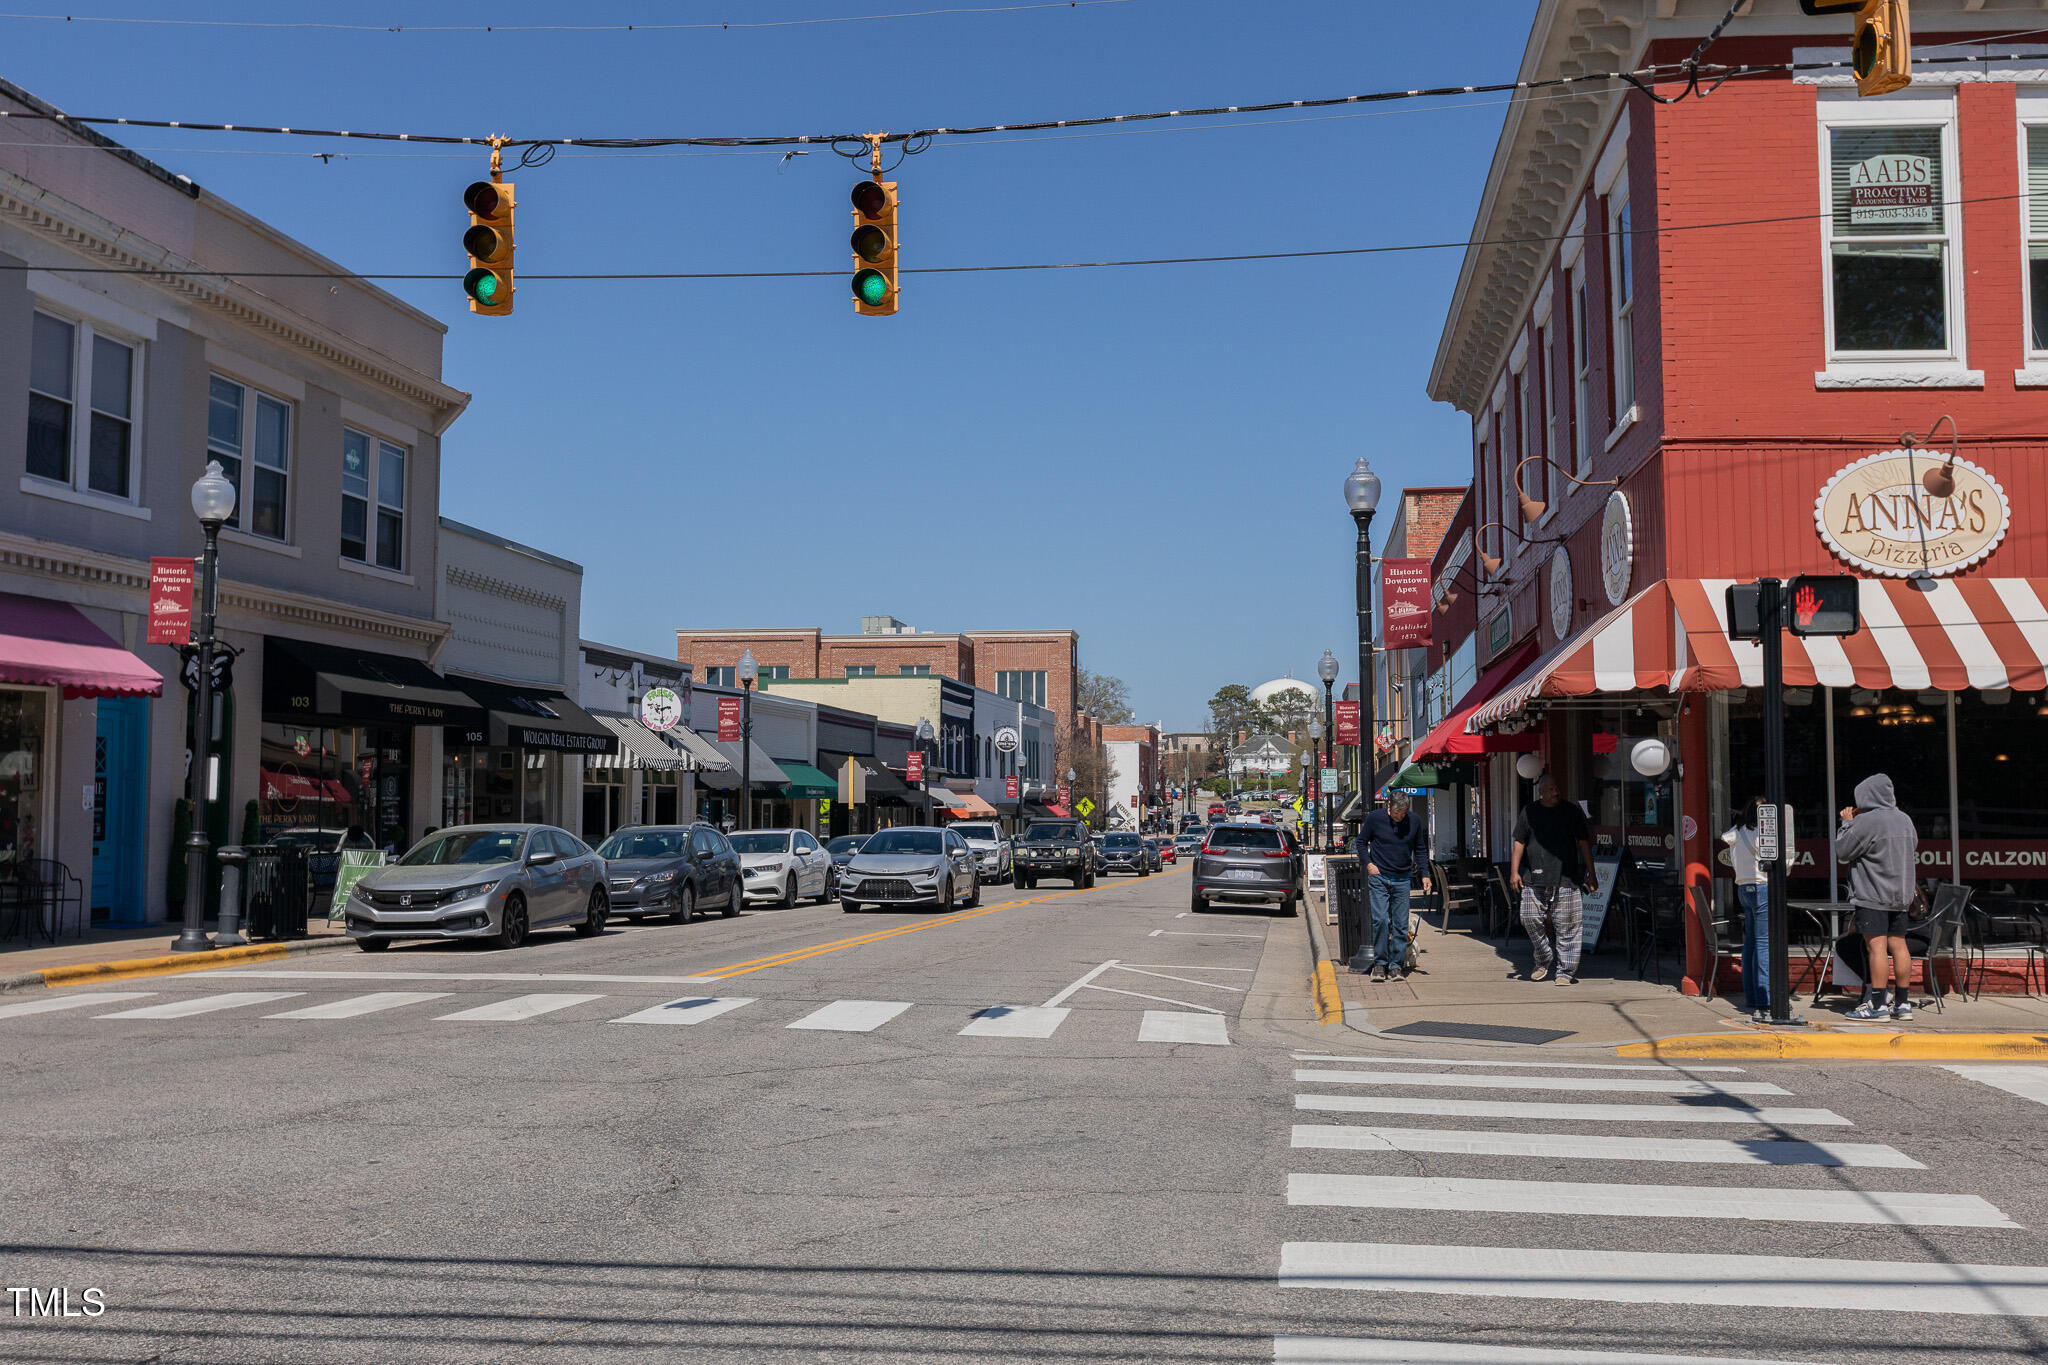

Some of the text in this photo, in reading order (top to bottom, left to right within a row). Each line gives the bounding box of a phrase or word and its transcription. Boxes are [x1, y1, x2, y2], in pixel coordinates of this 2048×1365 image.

[1855, 158, 1926, 183] AABS
[1855, 187, 1927, 198] PROACTIVE
[1855, 207, 1928, 219] 919-303-3345
[1840, 489, 1986, 535] ANNA'S
[1865, 537, 1965, 566] Pizzeria
[158, 567, 187, 575] Historic
[1389, 568, 1423, 576] Historic
[152, 575, 191, 584] Downtown
[1384, 577, 1428, 585] Downtown
[161, 584, 181, 592] Apex
[1396, 585, 1417, 594] Apex
[153, 619, 188, 627] Established
[1389, 622, 1428, 632] Established
[291, 696, 310, 707] 103
[389, 703, 444, 718] THE PERKY LADY
[466, 732, 483, 742] 105
[523, 729, 607, 750] WOLGIN REAL ESTATE GROUP
[1596, 834, 1613, 845] PIZZA
[1628, 835, 1662, 847] STROMBOLI
[1966, 851, 2048, 866] CALZON
